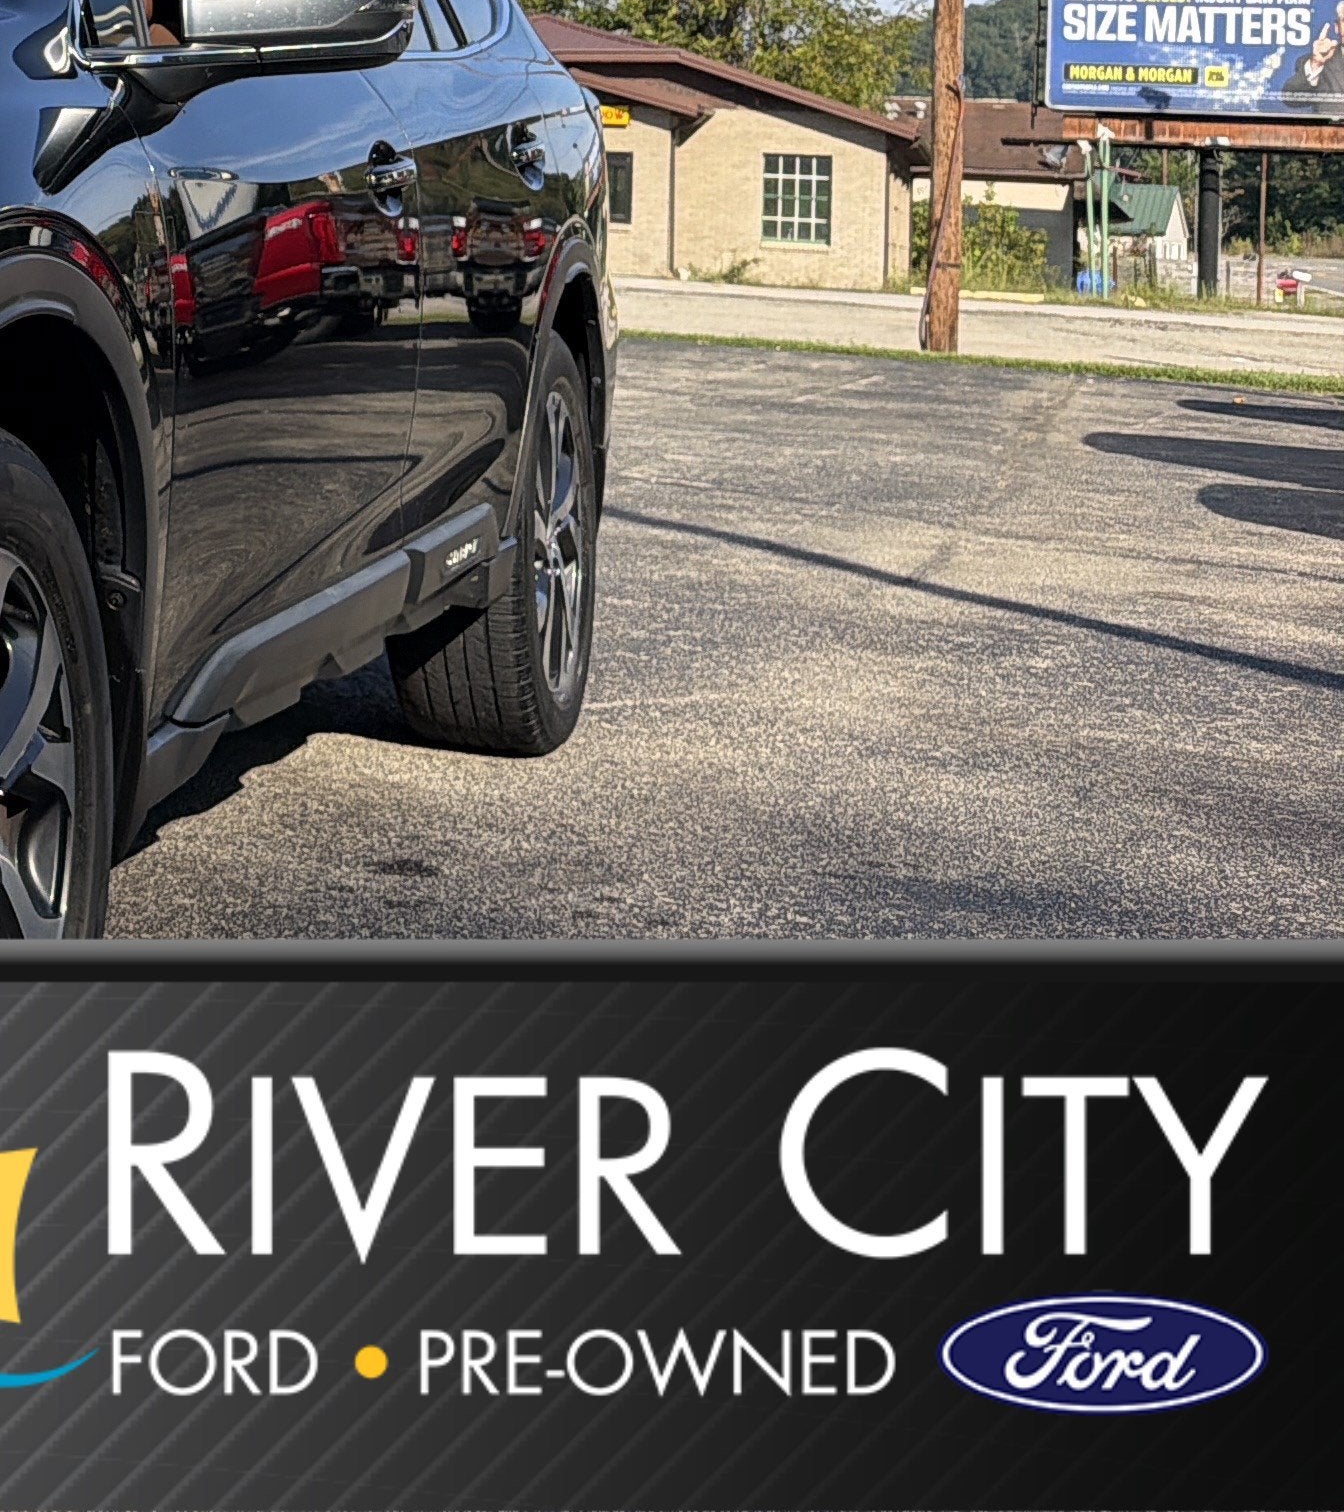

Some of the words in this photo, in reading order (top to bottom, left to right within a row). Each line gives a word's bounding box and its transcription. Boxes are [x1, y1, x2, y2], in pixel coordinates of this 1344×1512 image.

[1063, 3, 1138, 42] SIZE
[1144, 5, 1311, 46] MATTERS
[1069, 64, 1123, 82] MORGAN
[1125, 67, 1135, 82] &
[1138, 67, 1193, 84] MORGAN
